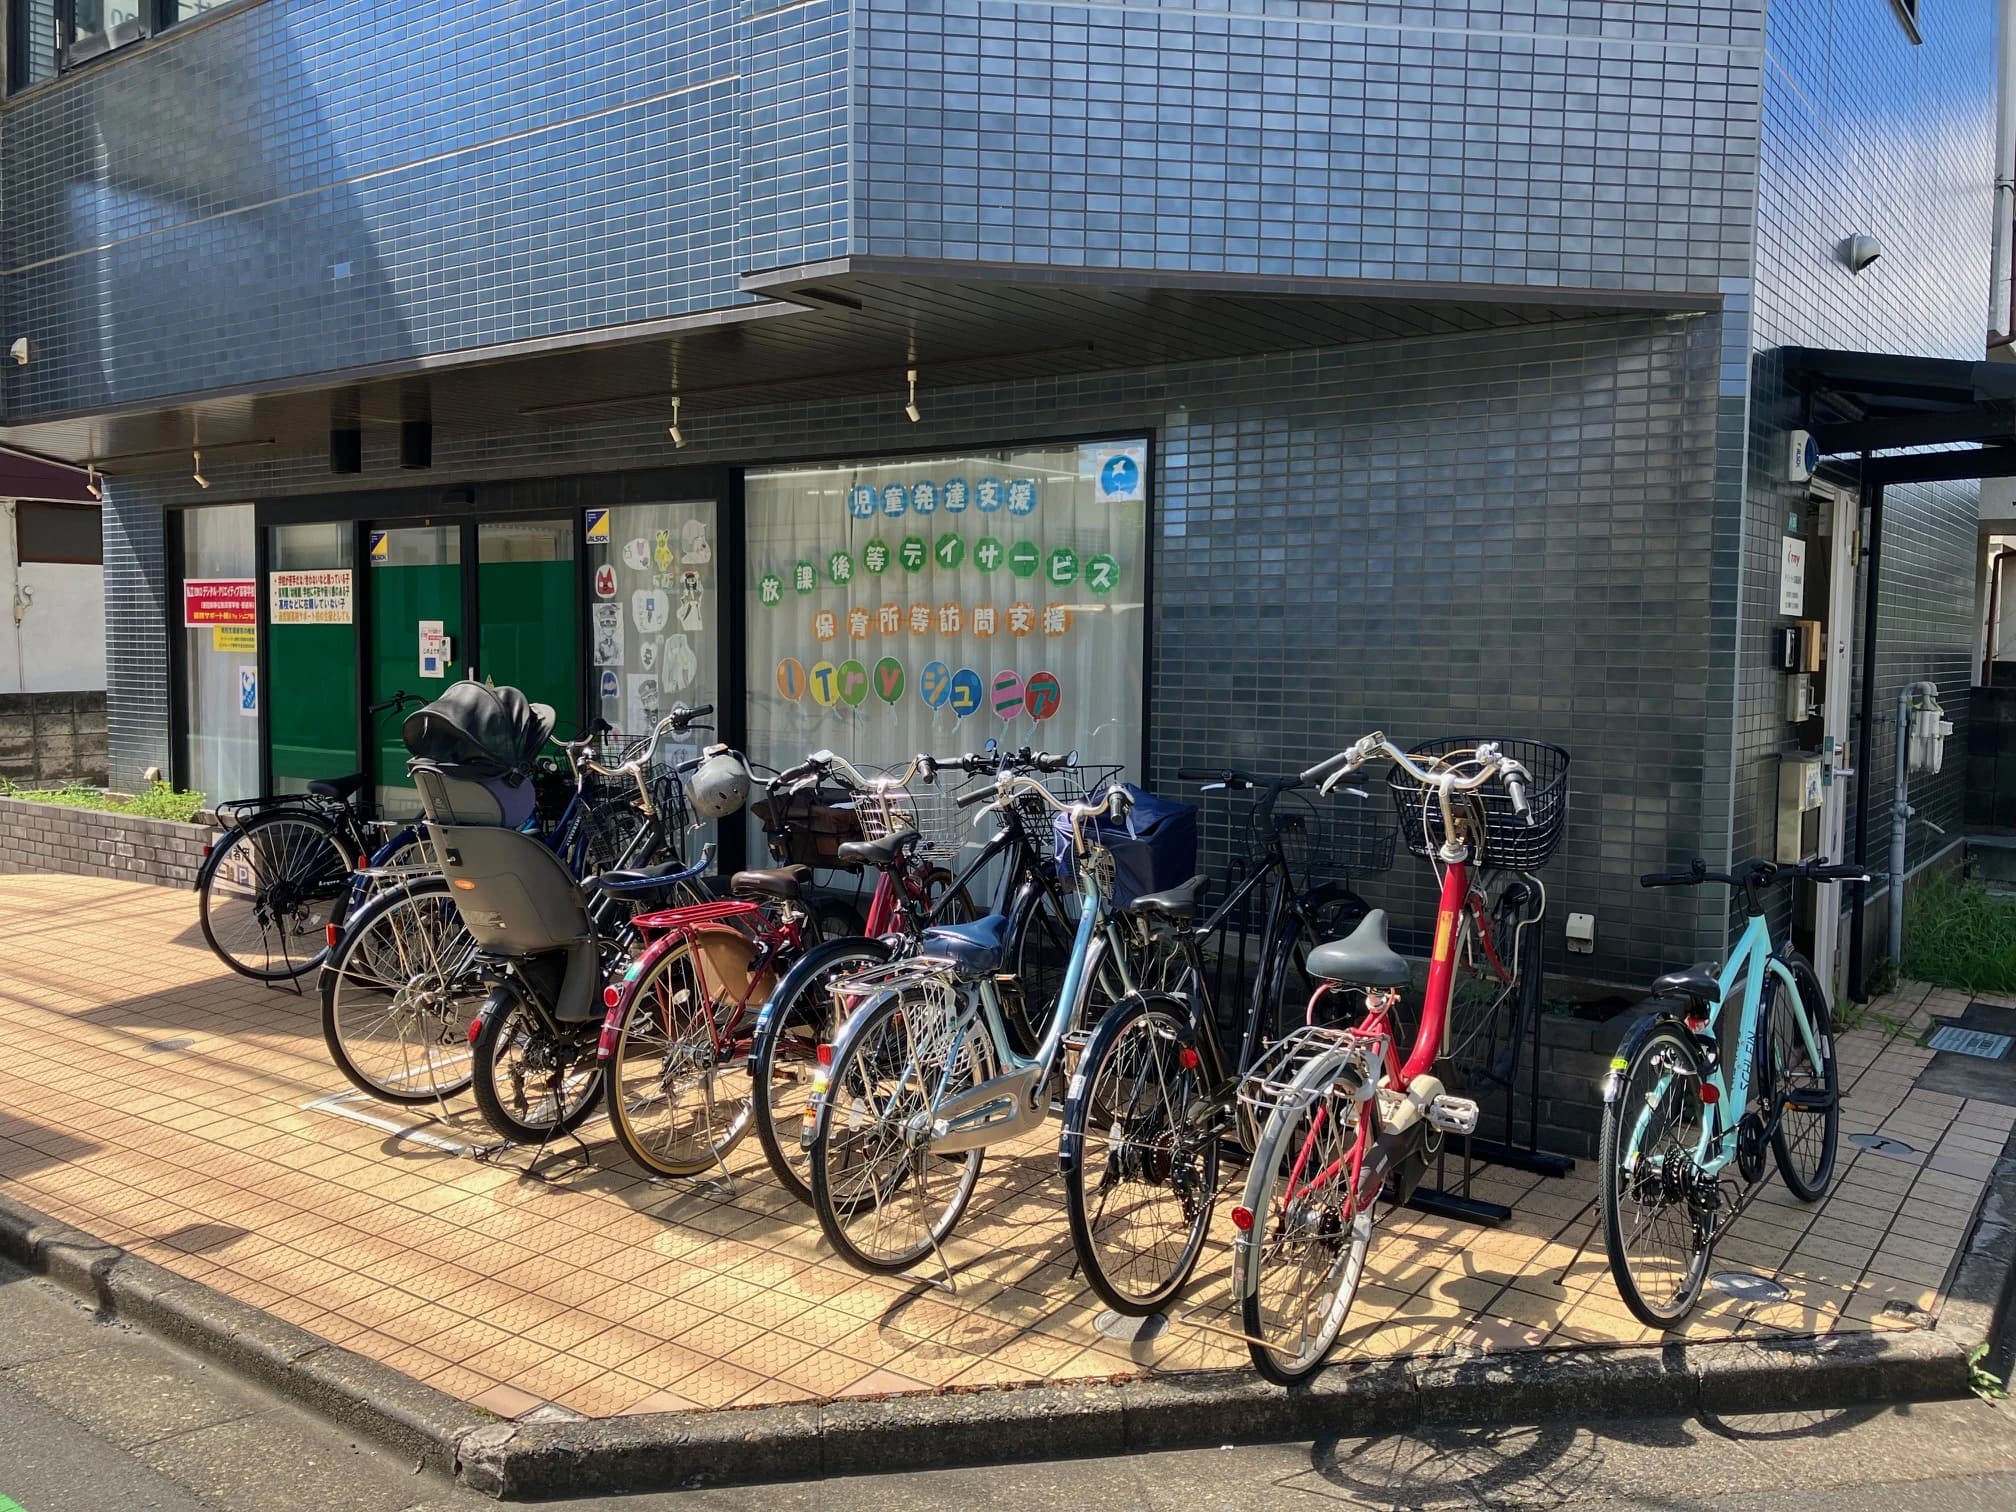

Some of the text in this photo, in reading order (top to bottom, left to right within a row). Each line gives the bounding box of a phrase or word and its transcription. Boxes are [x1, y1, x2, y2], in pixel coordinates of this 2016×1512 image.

[854, 480, 1030, 514] 児童発達支援
[761, 537, 1111, 603] 放課後等デイサービス
[815, 604, 1067, 638] 保育所等訪問支援
[924, 667, 1058, 716] ジュニア
[240, 868, 248, 880] P
[1740, 1030, 1756, 1091] SCHLEIN
